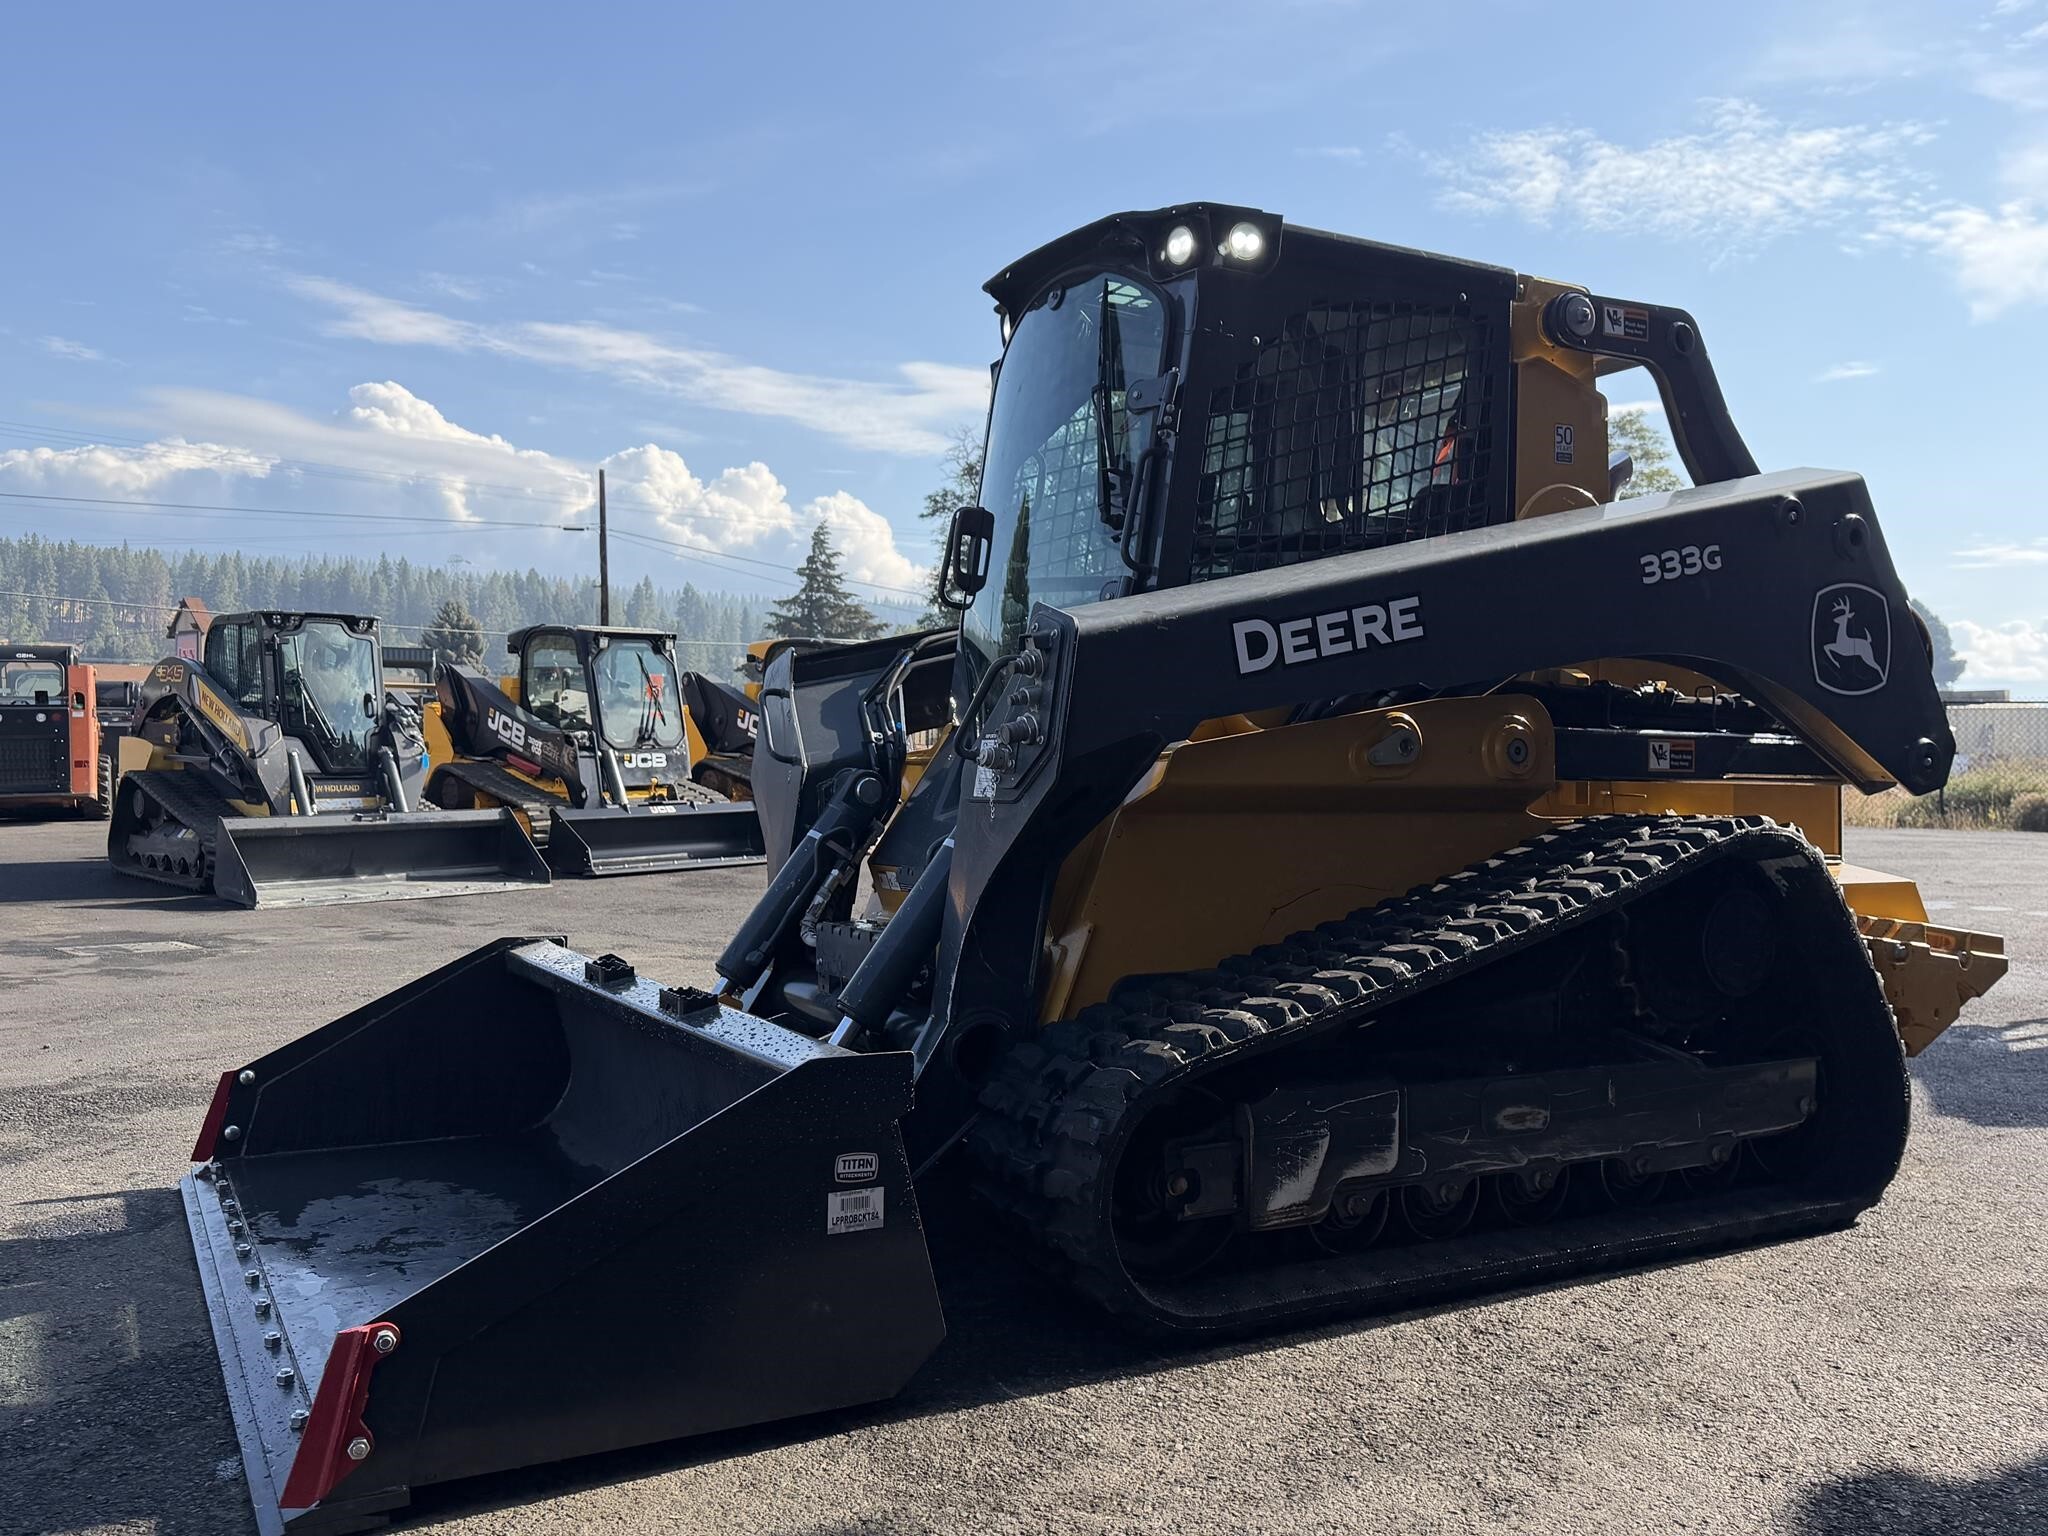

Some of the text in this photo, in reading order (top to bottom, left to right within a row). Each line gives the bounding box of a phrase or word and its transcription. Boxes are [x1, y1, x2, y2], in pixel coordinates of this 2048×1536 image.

[1556, 426, 1572, 446] 50
[1639, 544, 1723, 584] 333G
[1233, 596, 1424, 674] DEERE
[202, 691, 240, 736] NEW HOLLAND
[737, 709, 760, 734] JC
[487, 708, 526, 747] JCB
[624, 752, 668, 768] JCB
[324, 784, 360, 797] HOLLAND
[649, 806, 676, 814] JCB
[841, 1158, 873, 1170] TITAN
